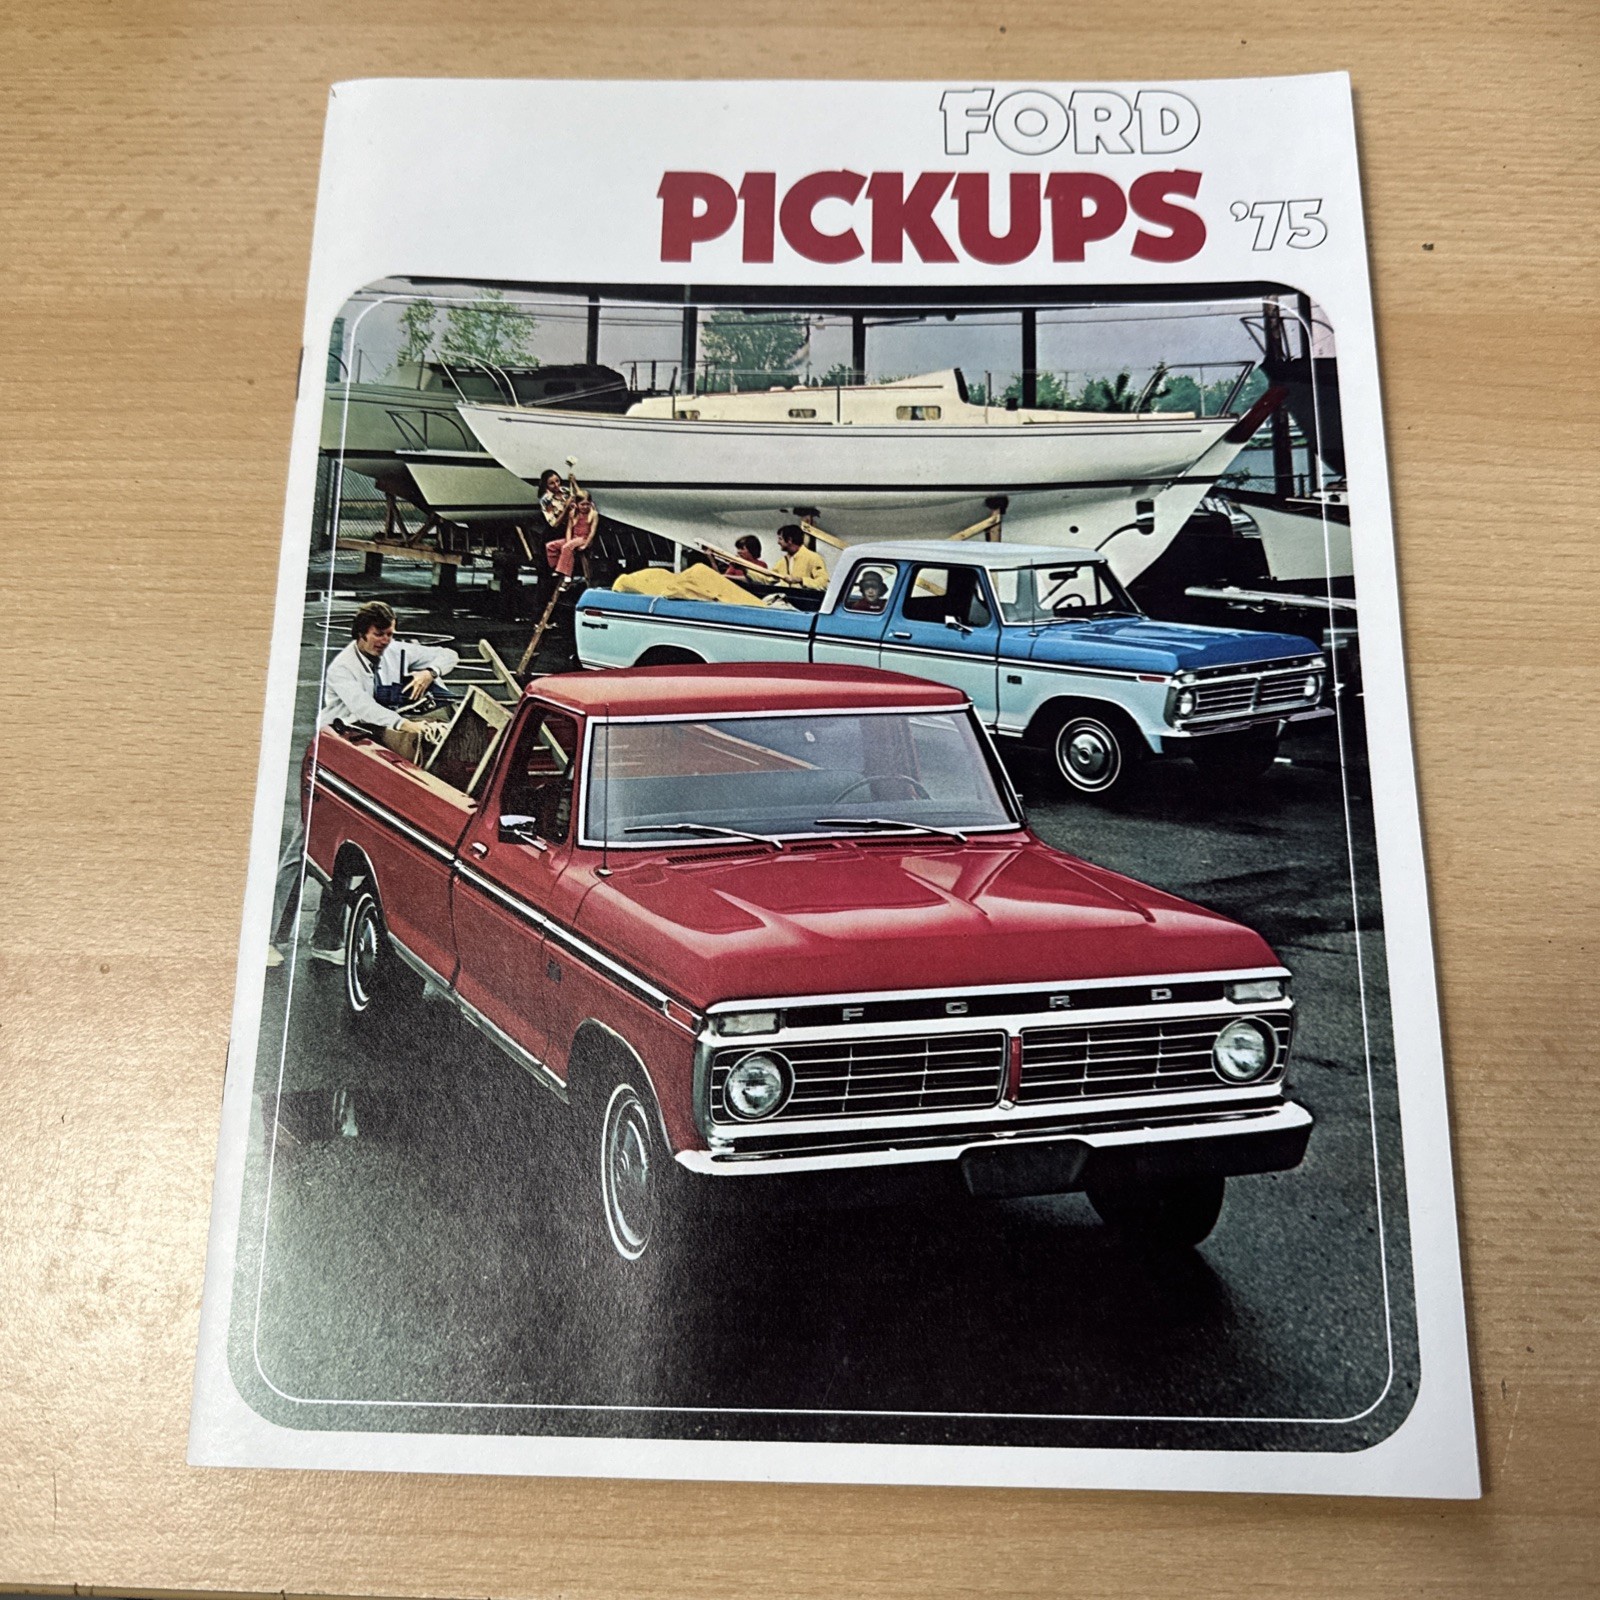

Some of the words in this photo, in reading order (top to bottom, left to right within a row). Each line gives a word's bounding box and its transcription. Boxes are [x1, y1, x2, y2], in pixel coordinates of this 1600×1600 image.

[939, 88, 1201, 156] FORD
[656, 168, 1207, 265] PICKUPS
[1229, 198, 1328, 252] '75
[842, 987, 1173, 1021] FORD
